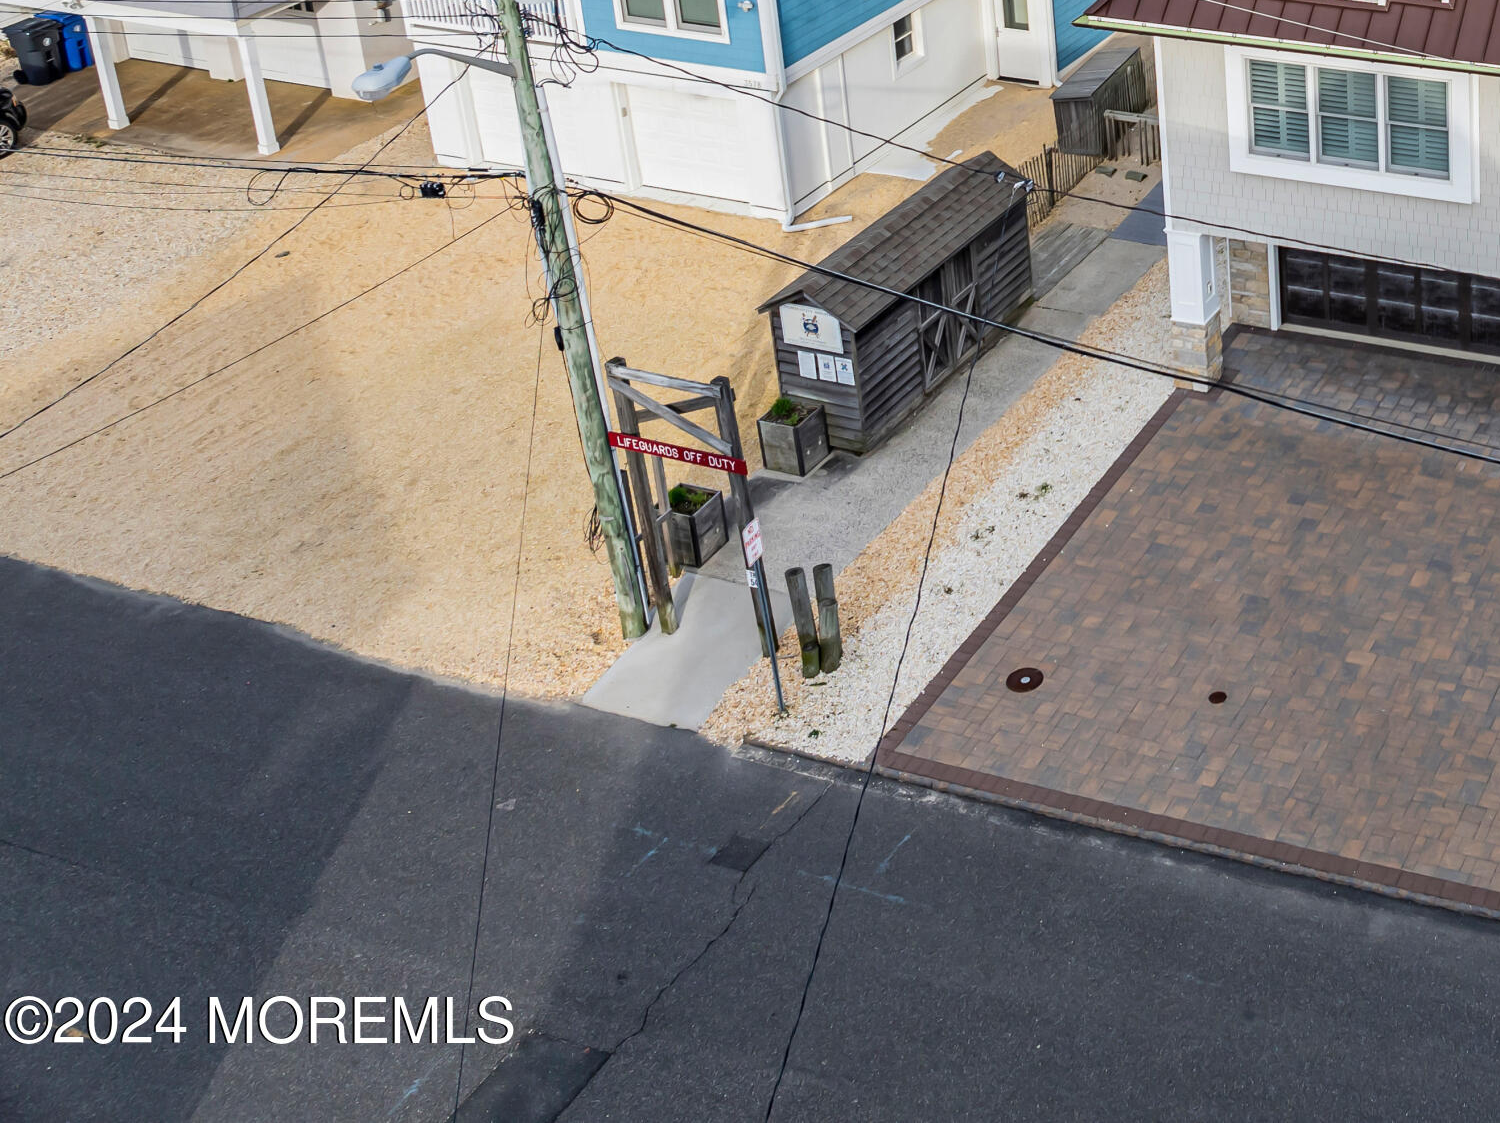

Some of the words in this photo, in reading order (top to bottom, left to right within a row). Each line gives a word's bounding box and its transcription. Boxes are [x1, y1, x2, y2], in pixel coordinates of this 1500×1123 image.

[616, 436, 679, 459] LIFEGUARDS
[683, 451, 703, 464] OFF
[708, 456, 737, 471] DUTY
